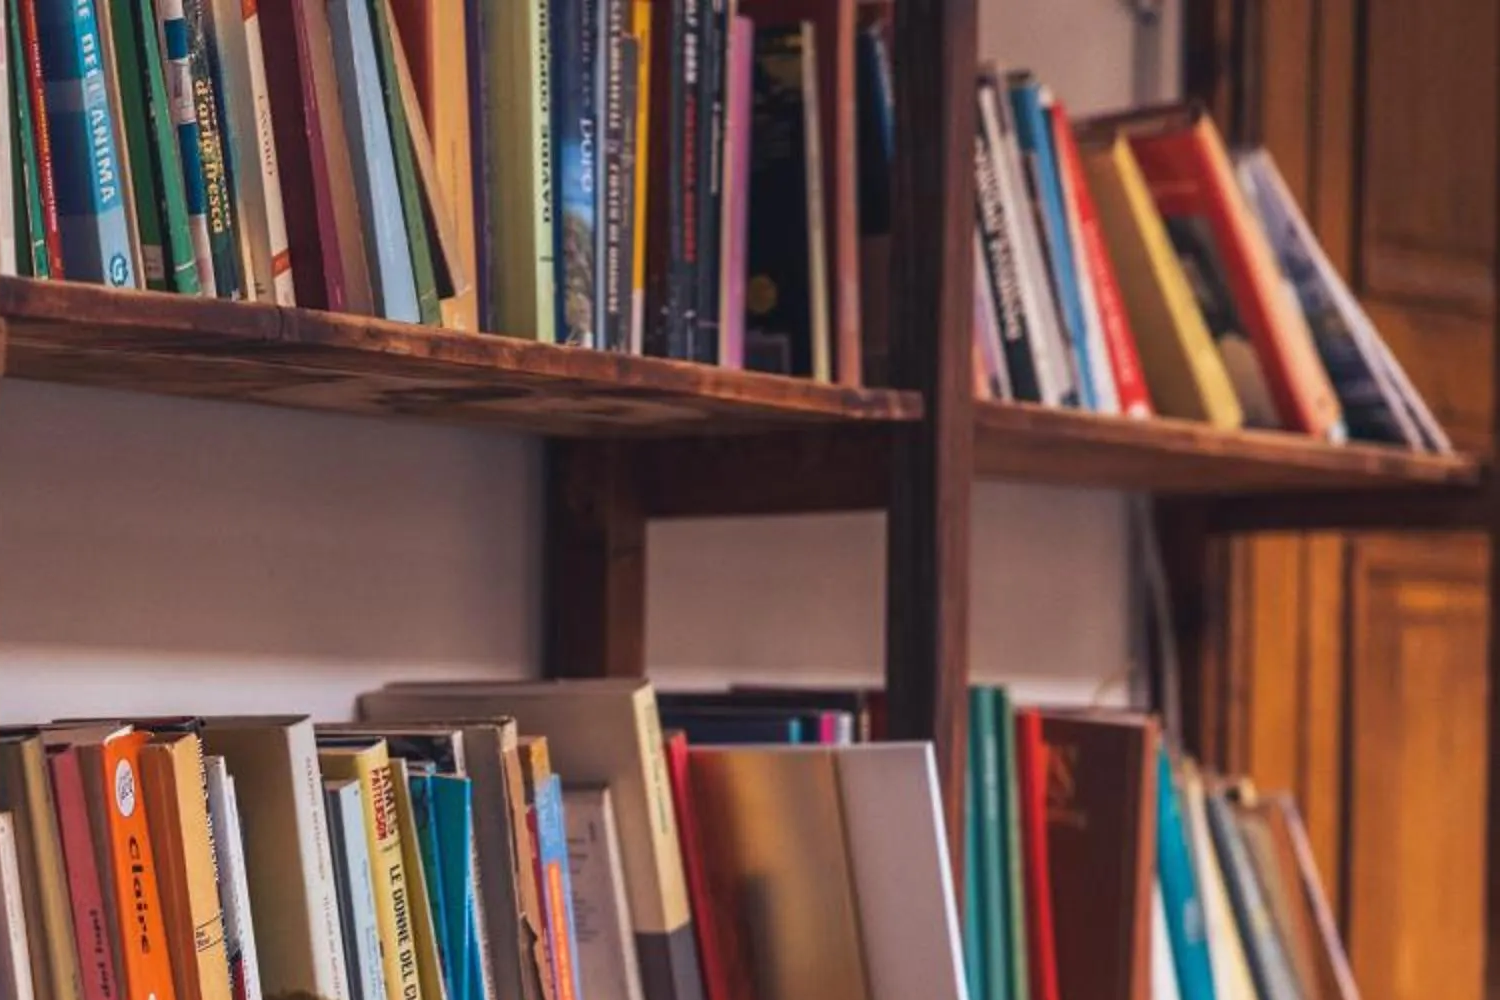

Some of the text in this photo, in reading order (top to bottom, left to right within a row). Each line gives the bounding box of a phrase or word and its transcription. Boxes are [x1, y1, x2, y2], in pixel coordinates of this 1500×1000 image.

[389, 864, 402, 881] LE
[392, 888, 410, 945] DONNE
[400, 950, 414, 982] DEL
